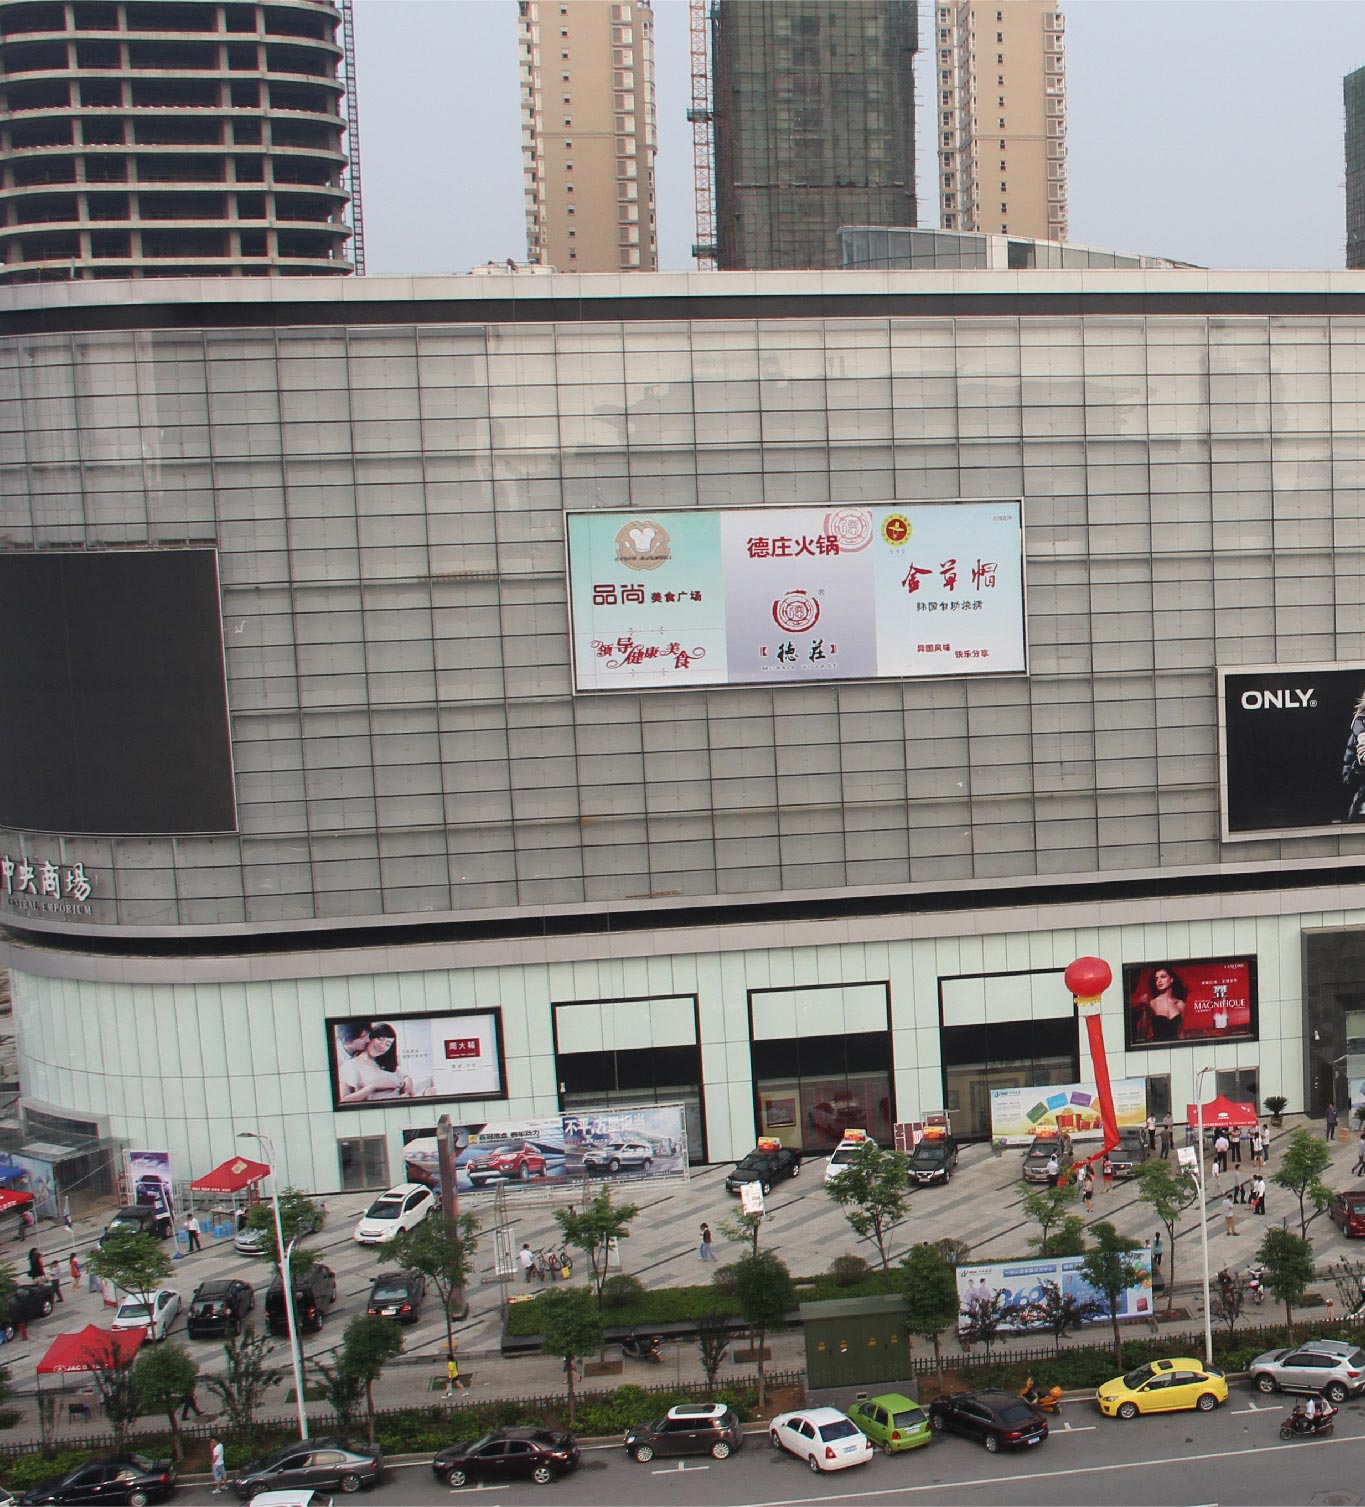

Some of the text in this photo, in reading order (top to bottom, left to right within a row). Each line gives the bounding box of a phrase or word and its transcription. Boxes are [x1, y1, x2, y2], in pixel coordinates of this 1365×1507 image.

[747, 535, 840, 558] 德庄火锅
[901, 558, 998, 594] 金草帽
[593, 584, 702, 606] 品尚 美食广场
[1241, 688, 1315, 709] ONLY
[1, 855, 92, 901] 中央商場
[42, 902, 92, 916] EMPORIUM
[1193, 998, 1247, 1010] MAGNIFIQUE
